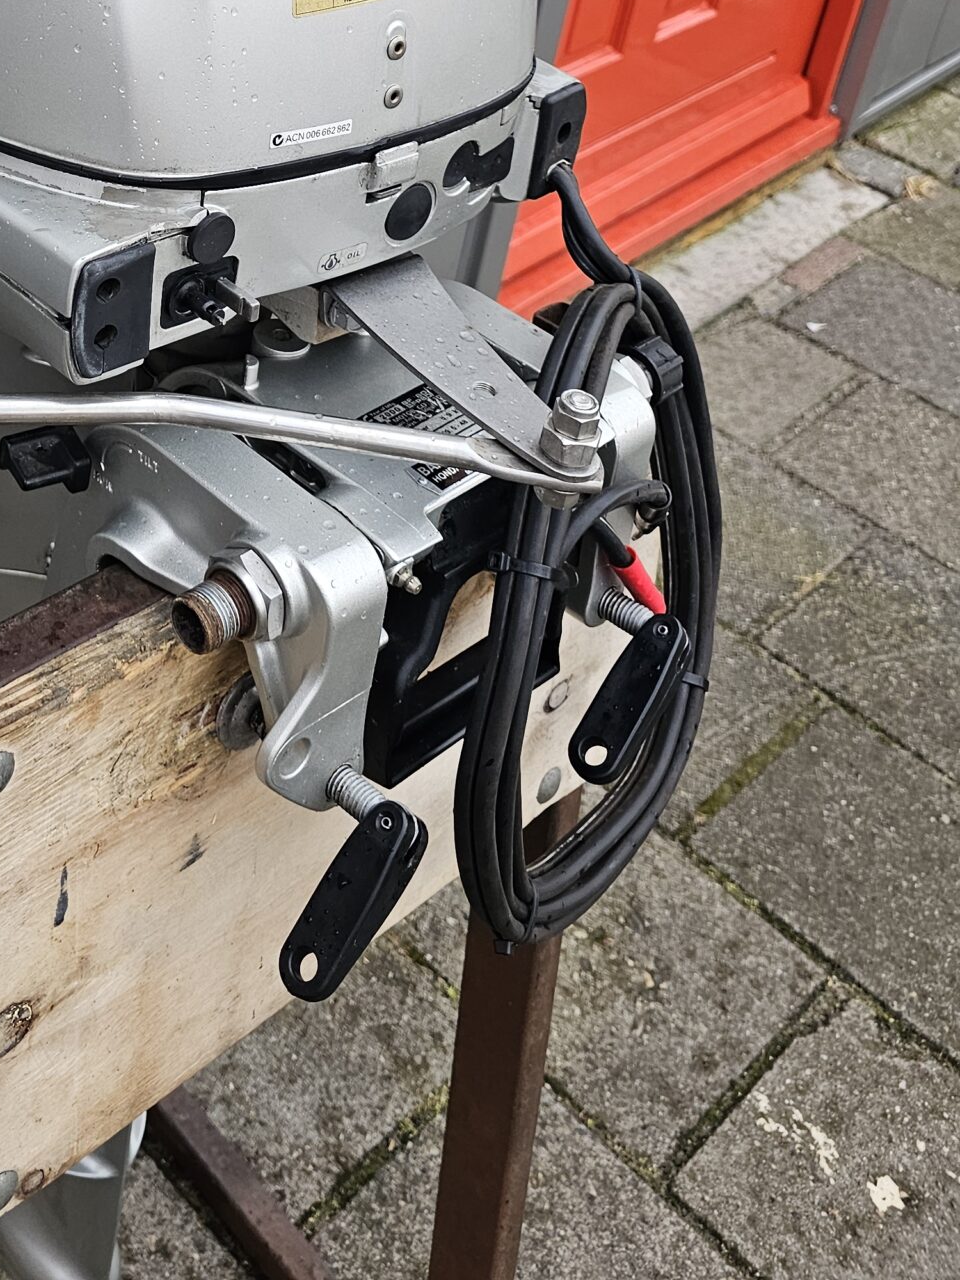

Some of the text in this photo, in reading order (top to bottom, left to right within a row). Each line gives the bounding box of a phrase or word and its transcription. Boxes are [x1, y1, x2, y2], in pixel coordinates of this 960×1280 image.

[285, 123, 351, 143] ACN 006 662 862
[347, 251, 360, 260] OIL
